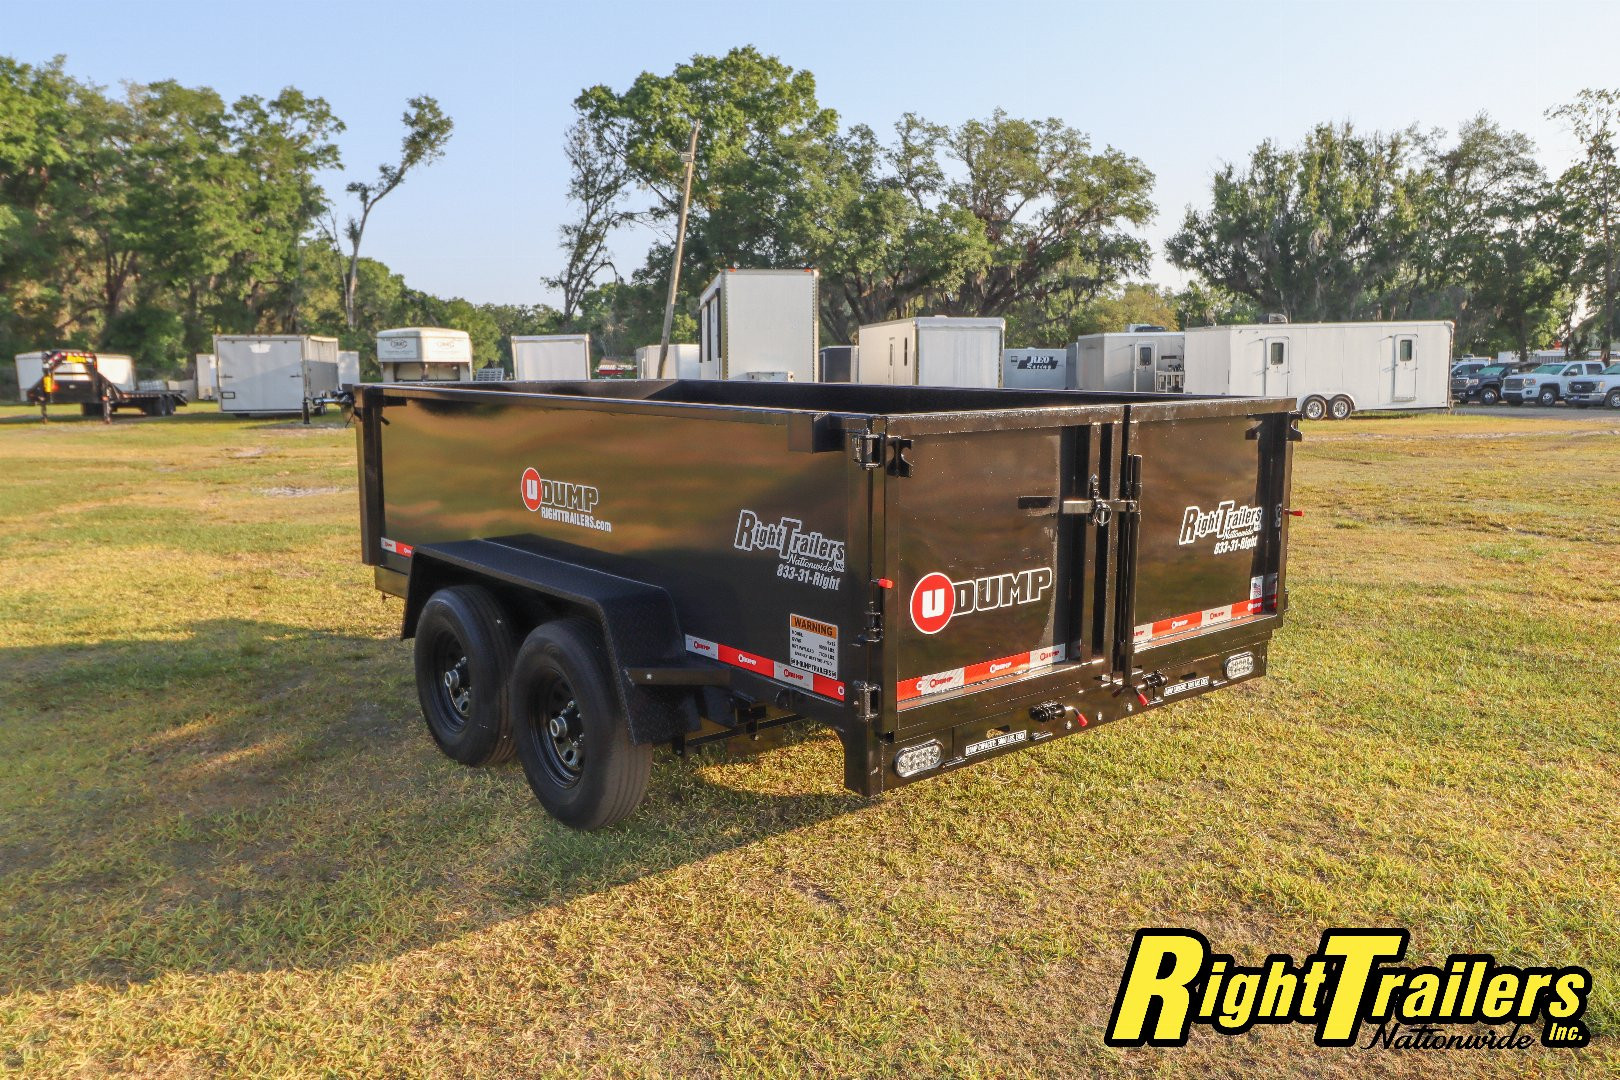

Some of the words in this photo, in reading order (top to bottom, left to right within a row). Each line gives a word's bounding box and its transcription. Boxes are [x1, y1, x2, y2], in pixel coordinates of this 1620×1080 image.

[541, 506, 612, 532] RIGHTTRAILERS.com
[1178, 500, 1263, 545] RightTrailers
[734, 509, 845, 562] RightTrailers
[776, 563, 841, 591] 833-31-Right
[786, 554, 834, 573] Nationwide
[794, 617, 833, 637] WARNING
